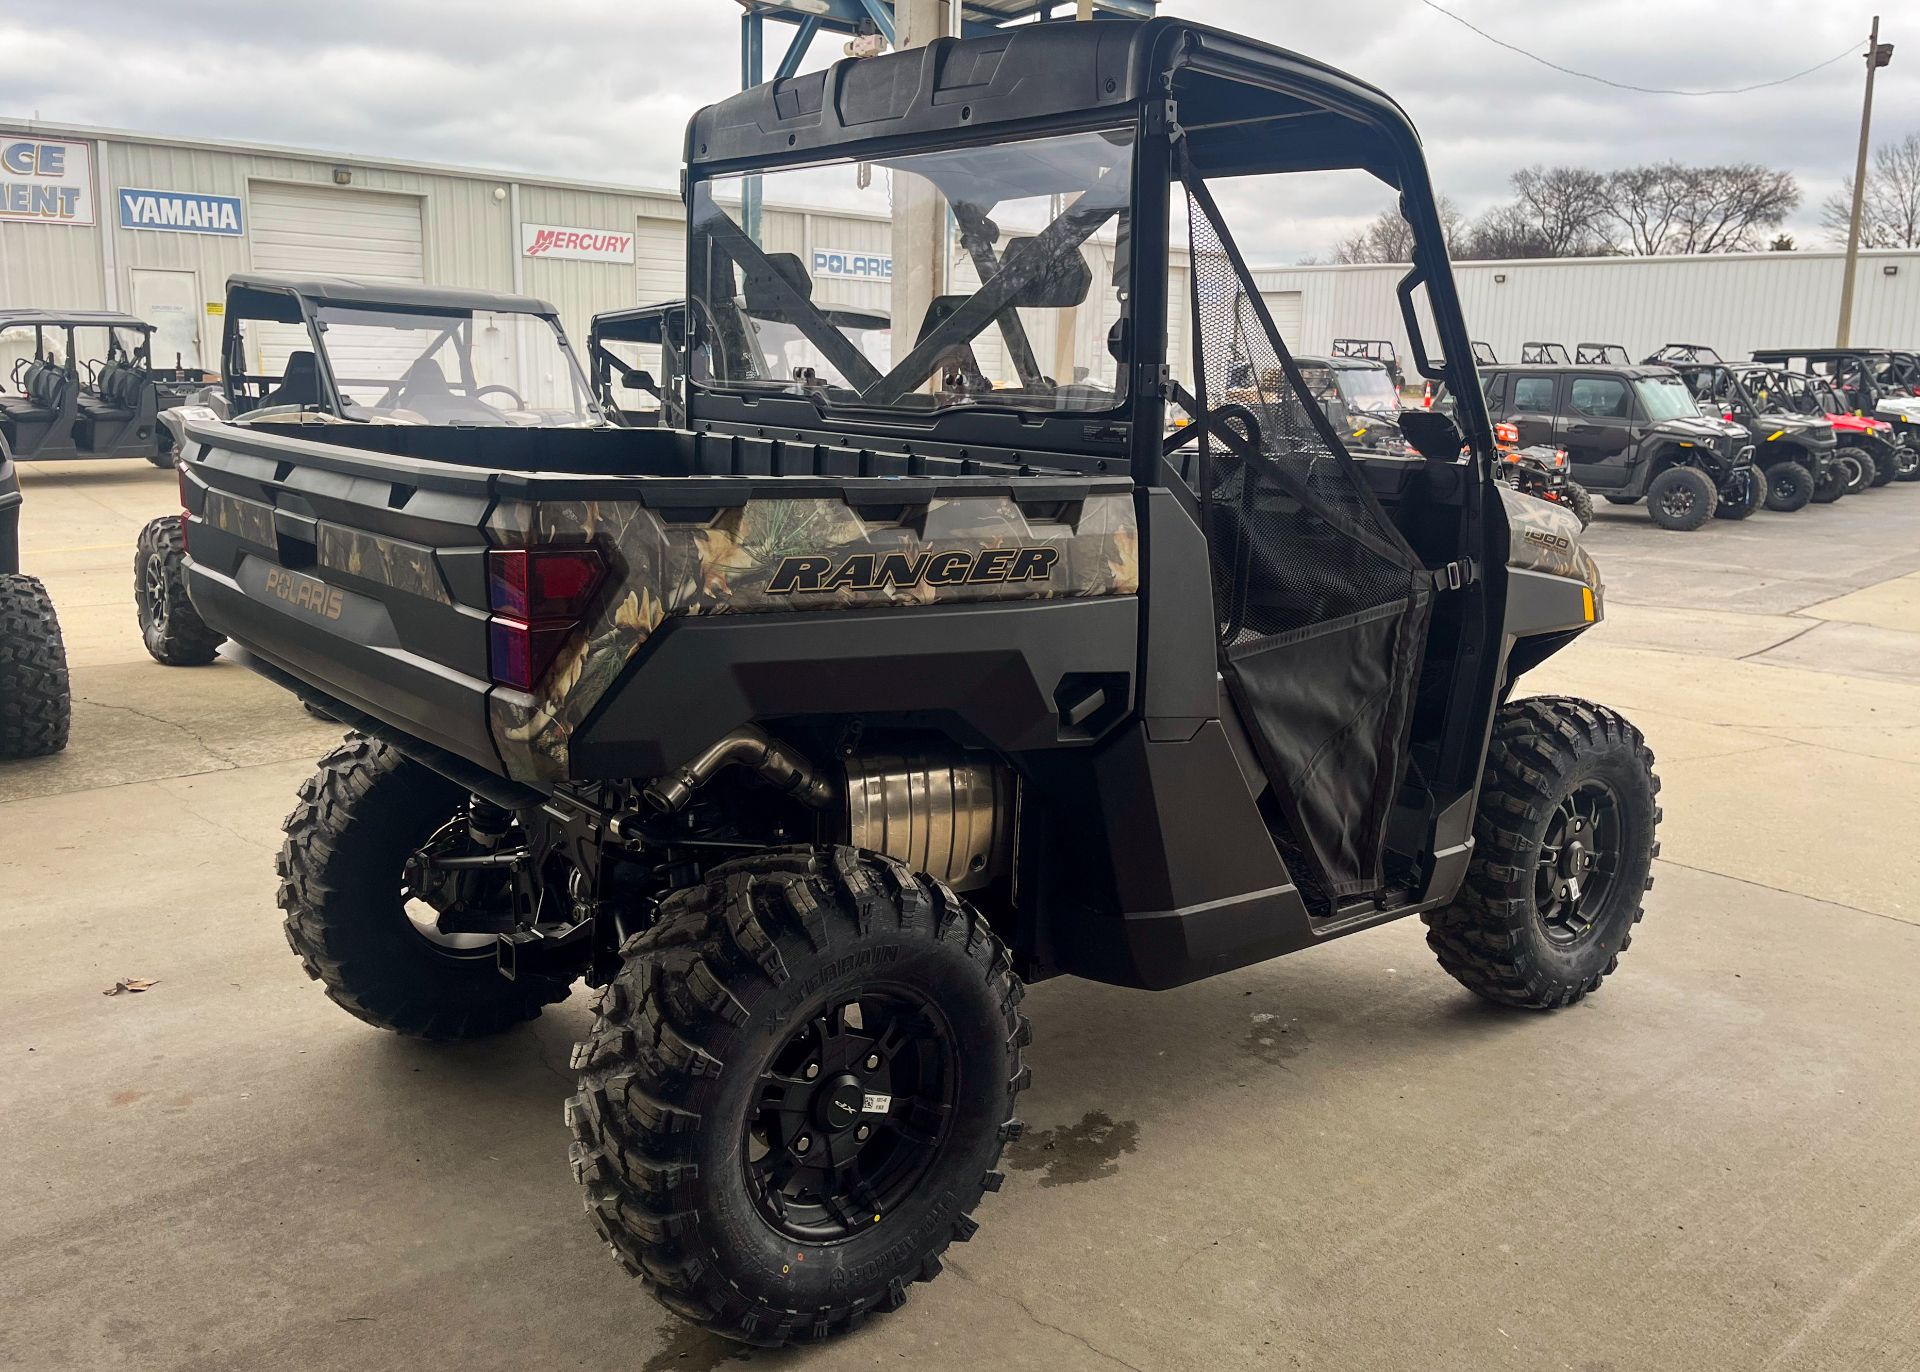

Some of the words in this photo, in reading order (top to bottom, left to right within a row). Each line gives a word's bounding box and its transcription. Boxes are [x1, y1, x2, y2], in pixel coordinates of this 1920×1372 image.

[124, 195, 238, 229] YAMAHA
[528, 230, 630, 254] MERCURY
[765, 547, 1059, 593] RANGER
[264, 566, 344, 620] POLARIS
